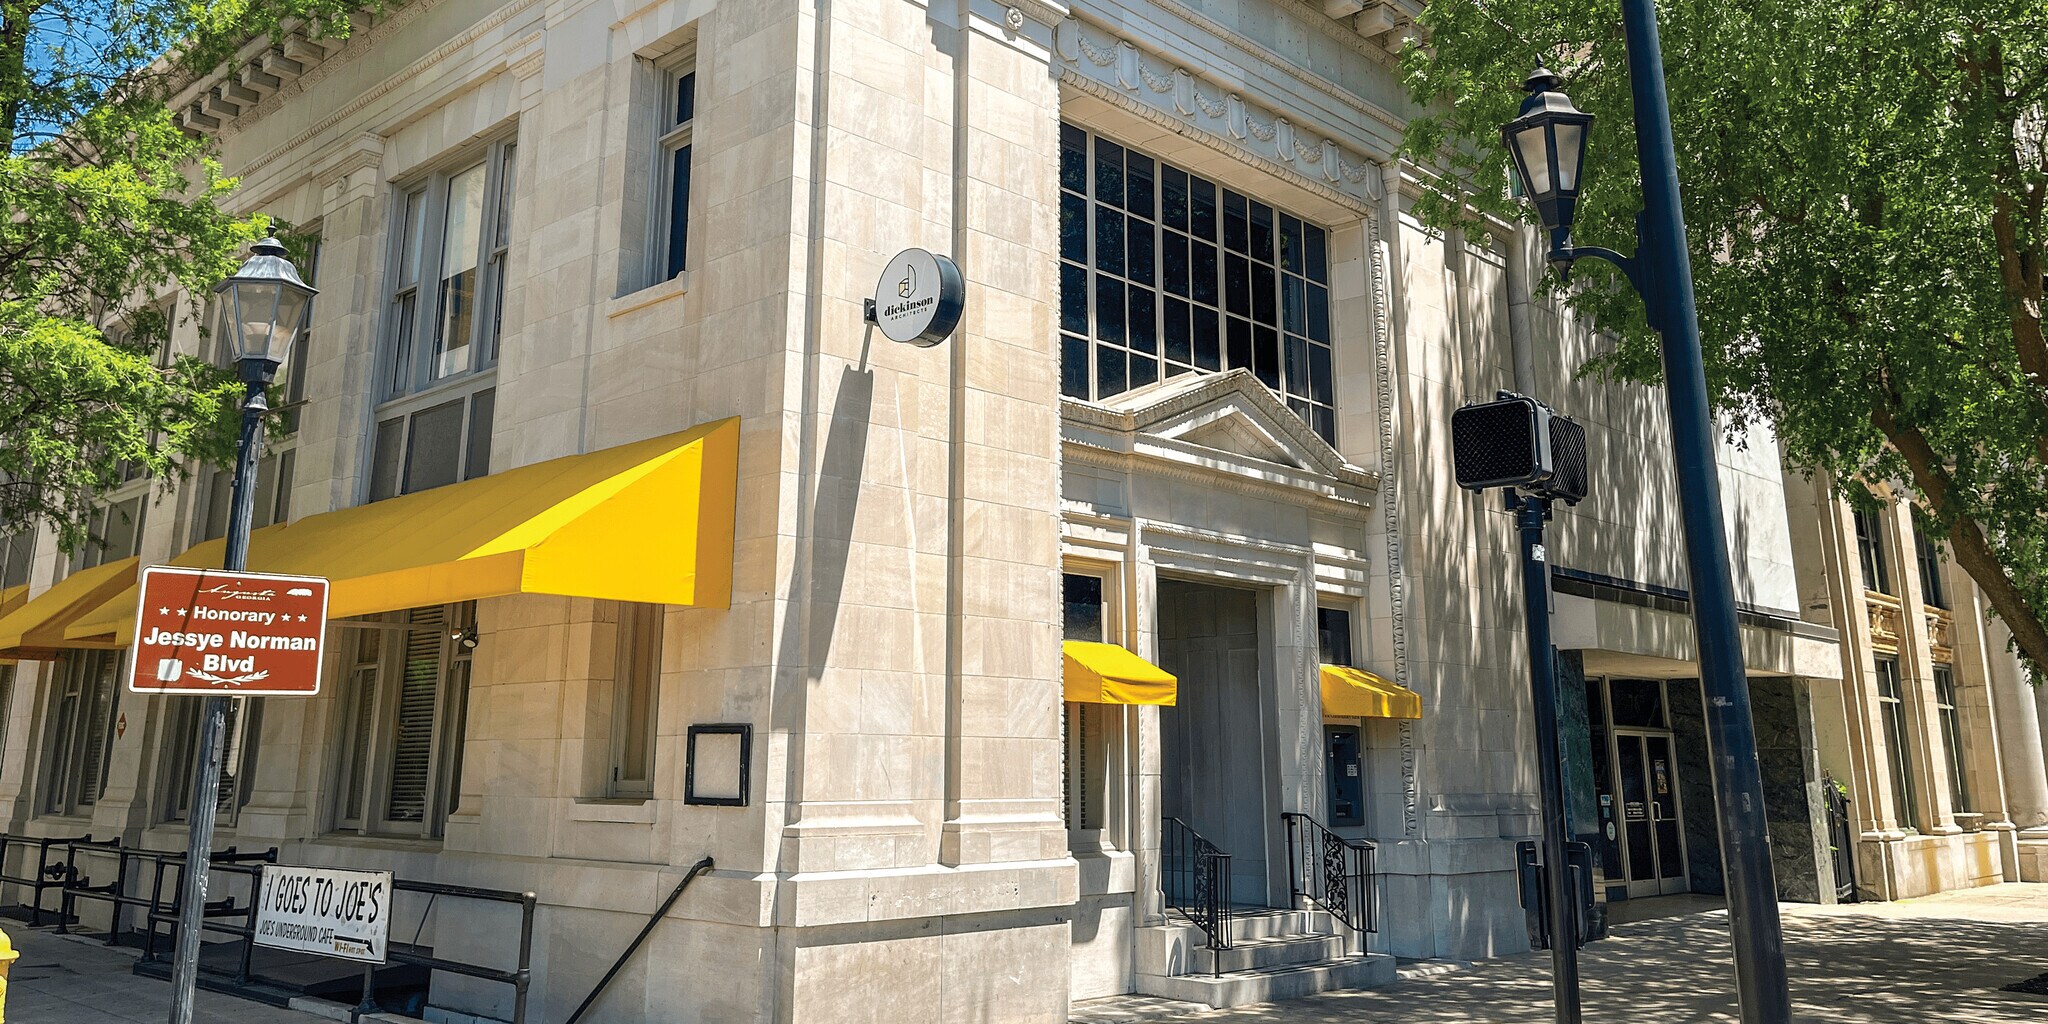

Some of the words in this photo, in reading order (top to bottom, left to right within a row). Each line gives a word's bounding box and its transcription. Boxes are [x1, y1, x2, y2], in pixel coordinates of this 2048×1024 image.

[884, 296, 934, 317] dickinson
[890, 307, 928, 321] ARCHITECTS
[198, 584, 277, 600] Augusta
[193, 606, 276, 626] Honorary
[143, 627, 223, 651] Jessye
[230, 630, 316, 651] Norman
[203, 654, 255, 673] Blvd
[264, 874, 274, 911] I
[275, 875, 311, 914] GOES
[313, 877, 333, 917] TO
[335, 880, 382, 924] JOE'S
[275, 922, 318, 943] UNDERGROUND
[318, 927, 334, 945] CAFE
